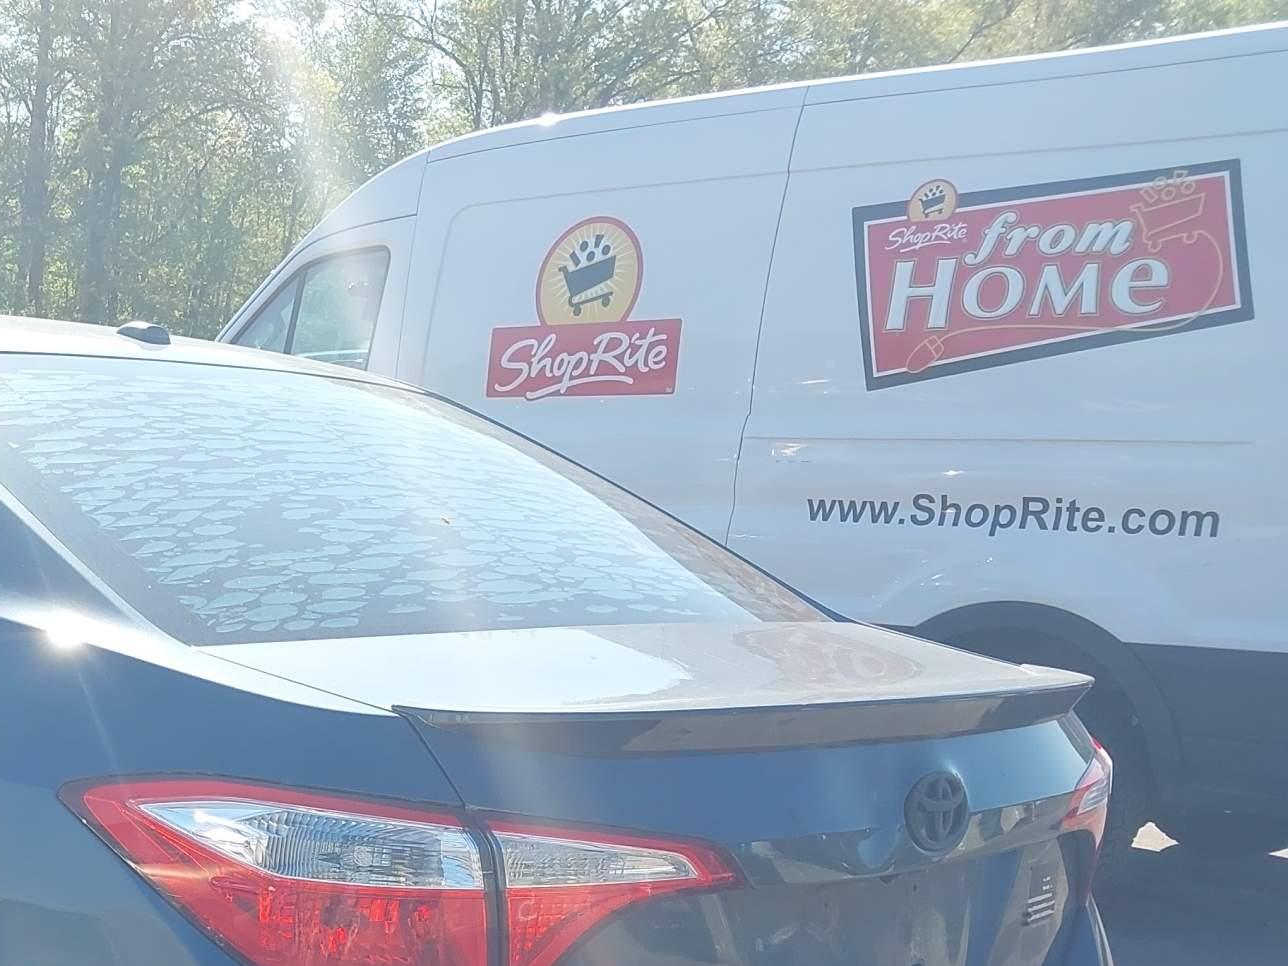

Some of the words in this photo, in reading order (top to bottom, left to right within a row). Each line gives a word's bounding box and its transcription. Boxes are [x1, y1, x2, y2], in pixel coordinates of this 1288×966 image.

[885, 222, 969, 250] ShopRite
[964, 211, 1134, 265] from
[494, 327, 668, 395] ShopRite
[806, 493, 1221, 538] www.ShopRite.com
